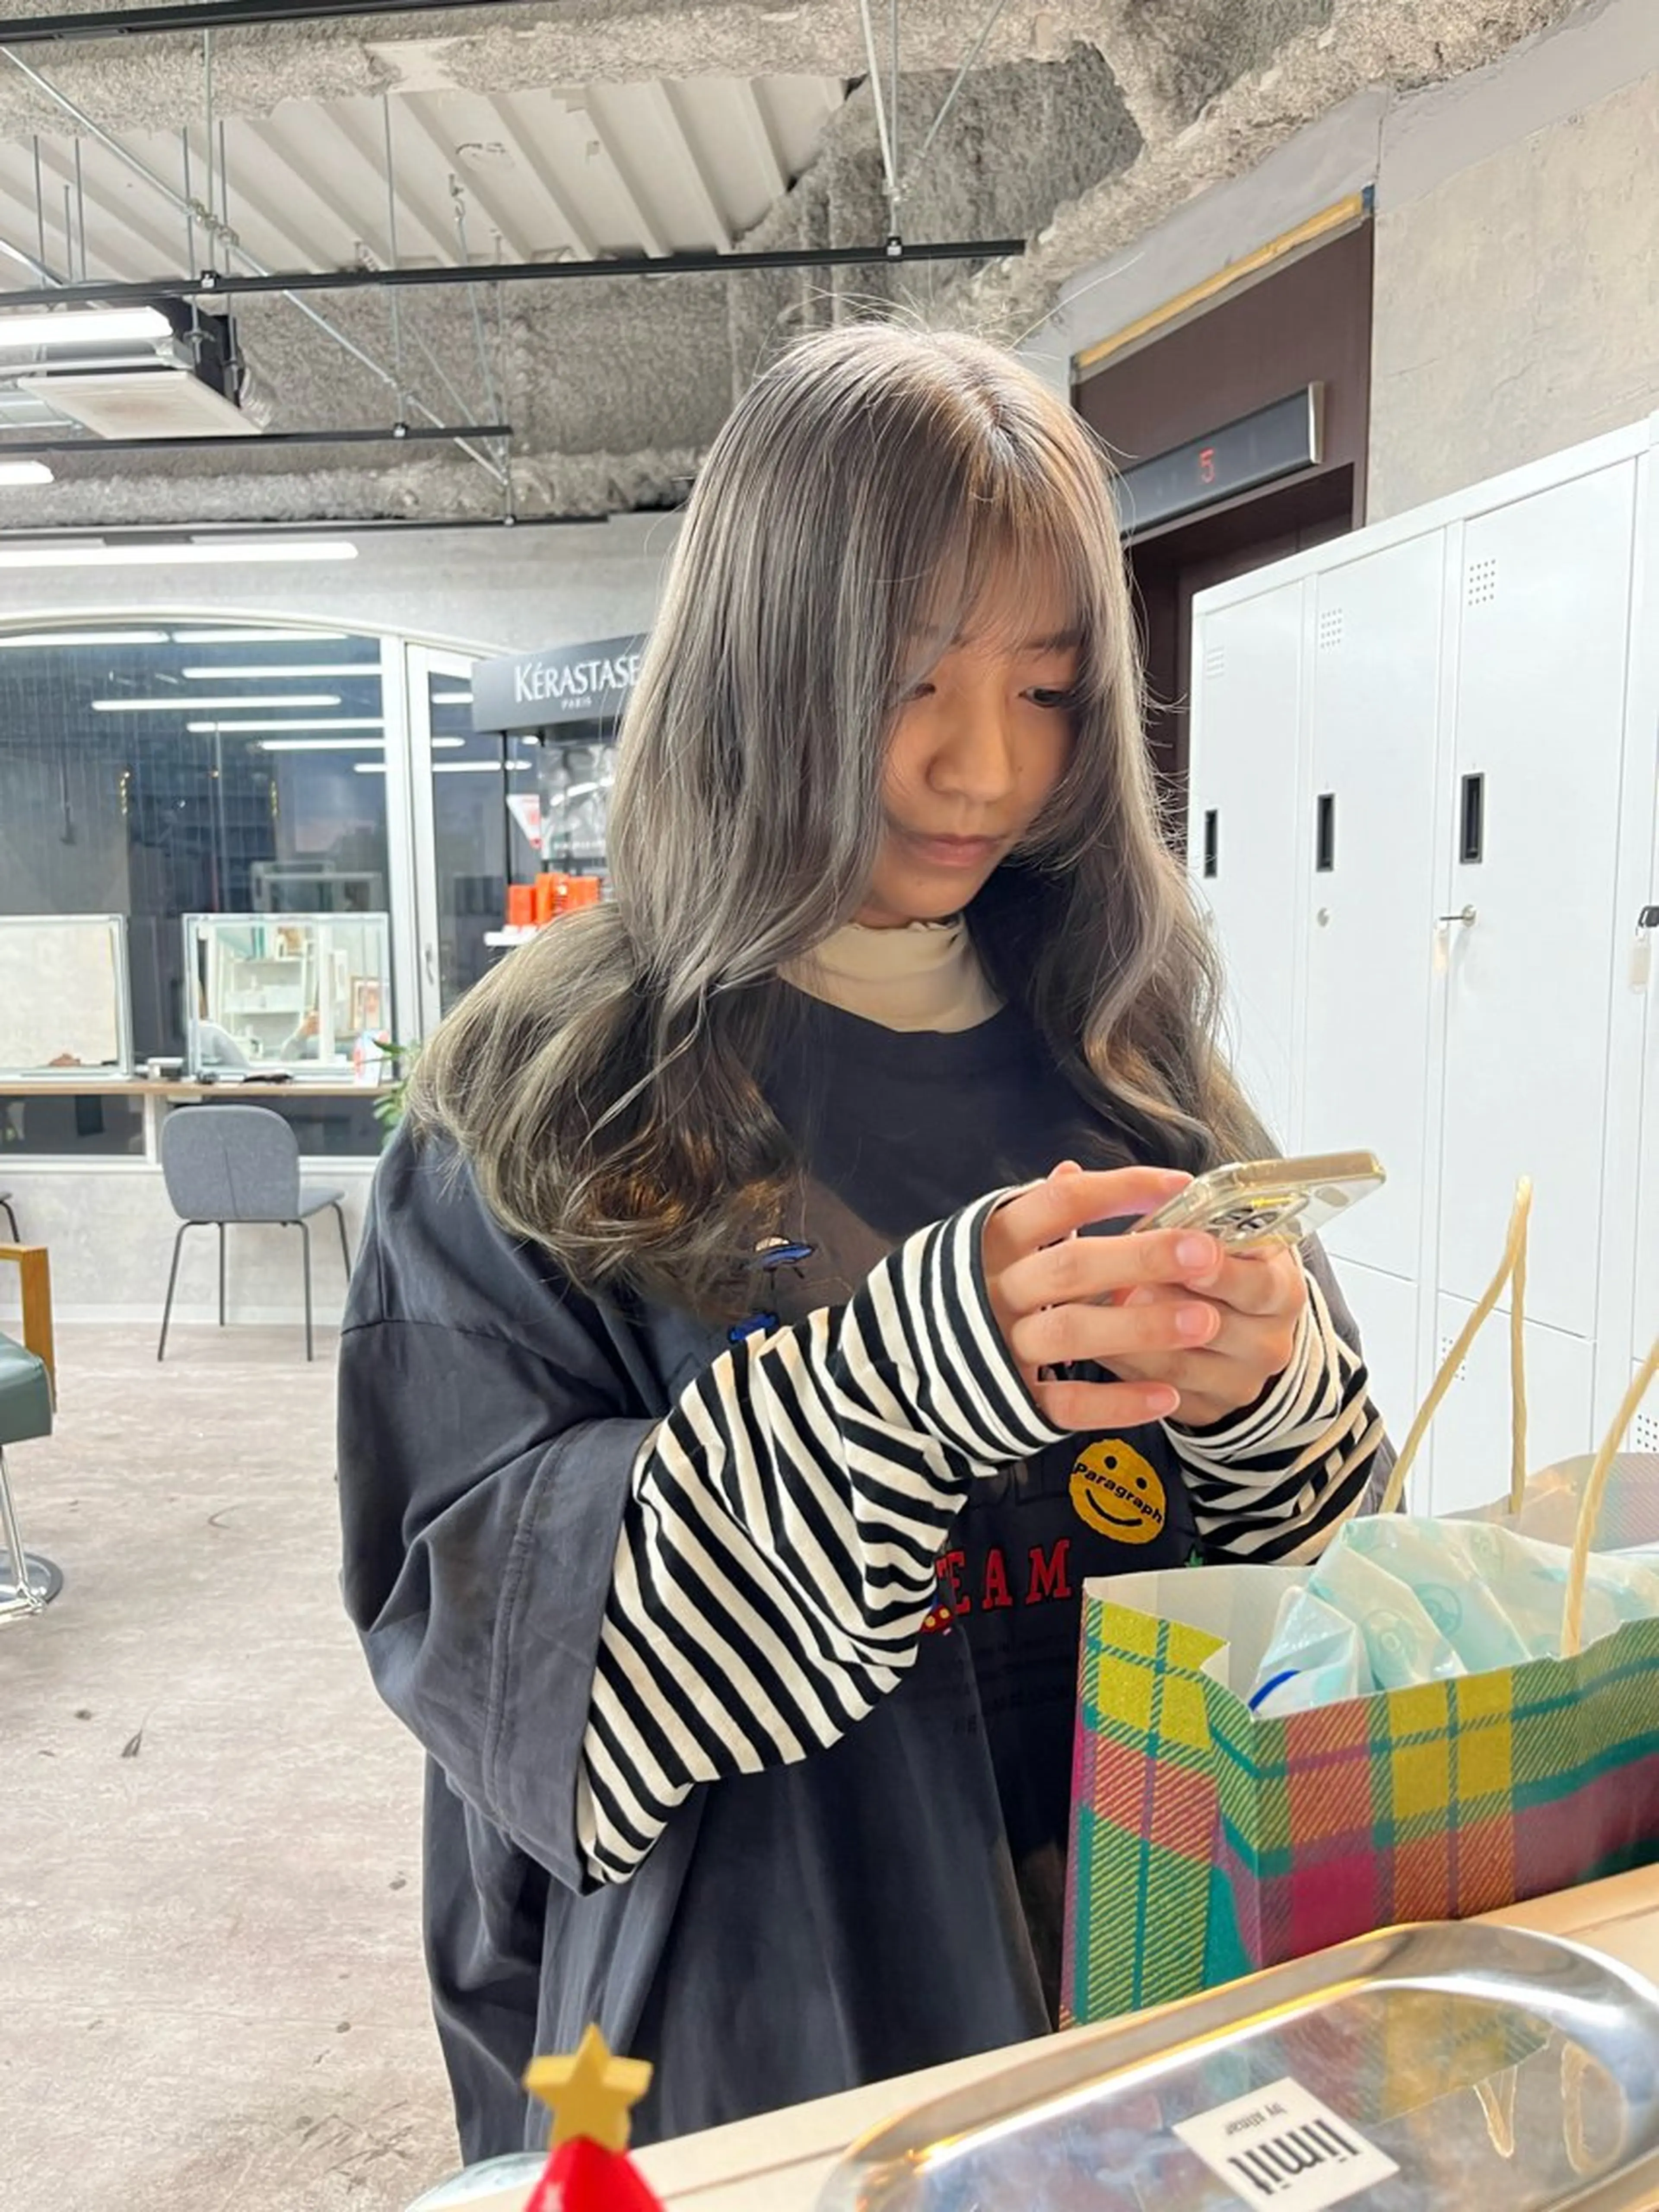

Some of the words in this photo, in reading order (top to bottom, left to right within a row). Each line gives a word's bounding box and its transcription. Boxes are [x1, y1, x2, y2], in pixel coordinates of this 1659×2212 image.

[1199, 447, 1215, 483] 5
[561, 696, 592, 710] PARIS
[1073, 1462, 1162, 1523] Paragraph
[1227, 2119, 1360, 2195] limit
